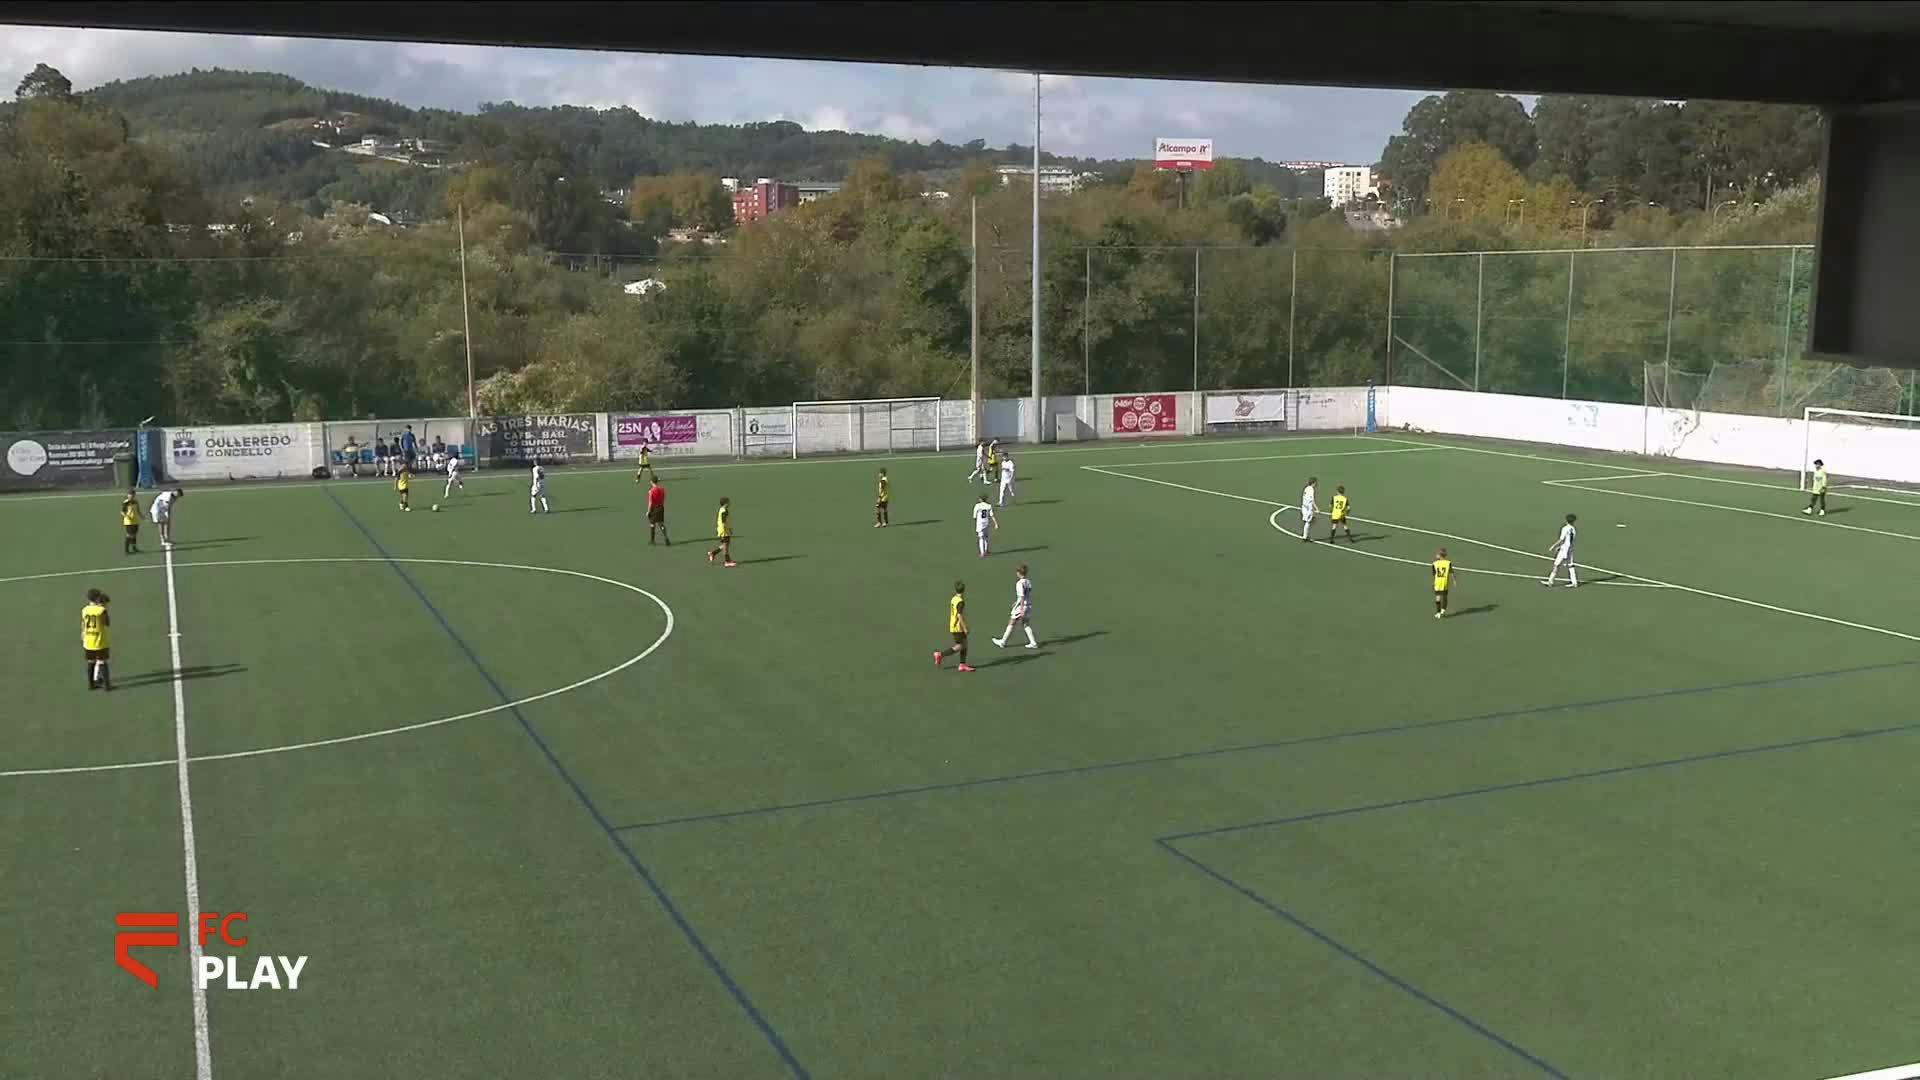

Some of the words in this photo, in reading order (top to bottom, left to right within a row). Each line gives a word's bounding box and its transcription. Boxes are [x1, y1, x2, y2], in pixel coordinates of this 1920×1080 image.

[1158, 143, 1197, 153] Alcampo
[618, 423, 642, 434] 25N
[206, 448, 272, 457] CONCELLO
